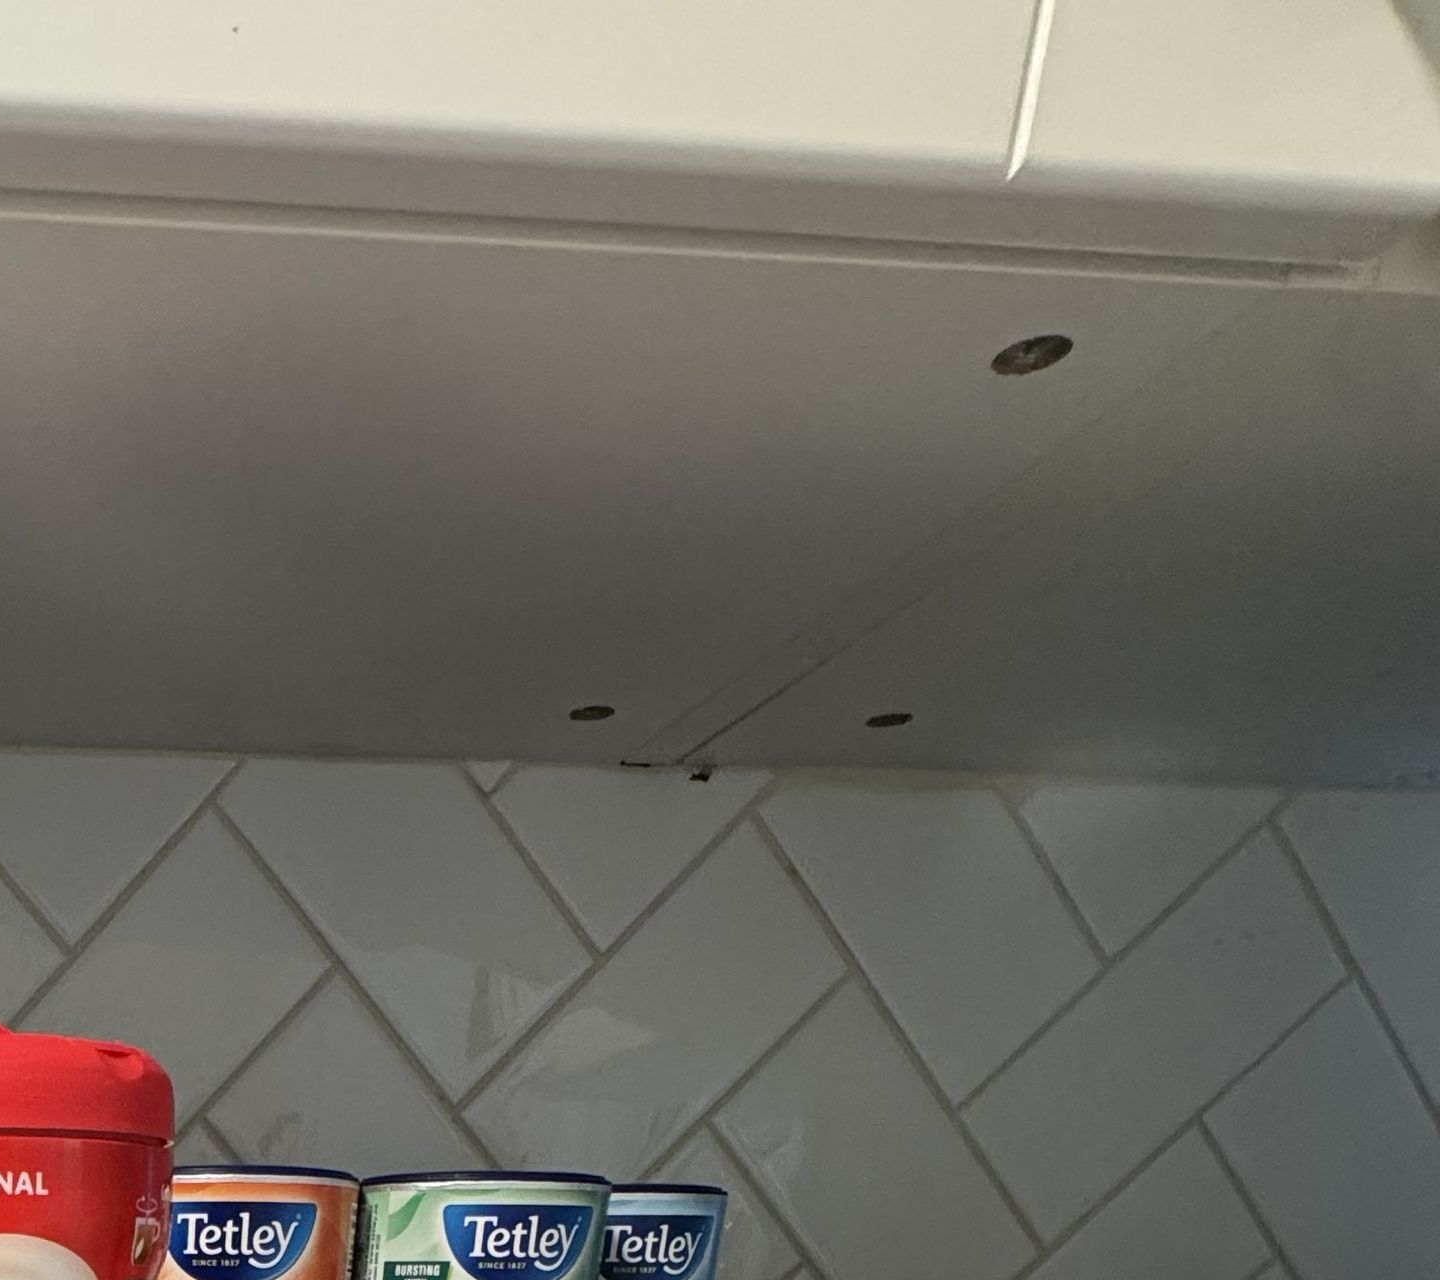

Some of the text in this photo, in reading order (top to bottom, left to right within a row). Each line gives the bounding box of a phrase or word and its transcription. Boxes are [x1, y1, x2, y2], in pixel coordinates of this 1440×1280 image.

[177, 1212, 299, 1269] Tetley
[464, 1215, 579, 1271] Tetley
[603, 1224, 703, 1275] Tetley
[192, 1259, 240, 1267] SINCE 1837
[394, 1264, 440, 1277] BURSTING
[478, 1262, 527, 1270] SINCE 1837
